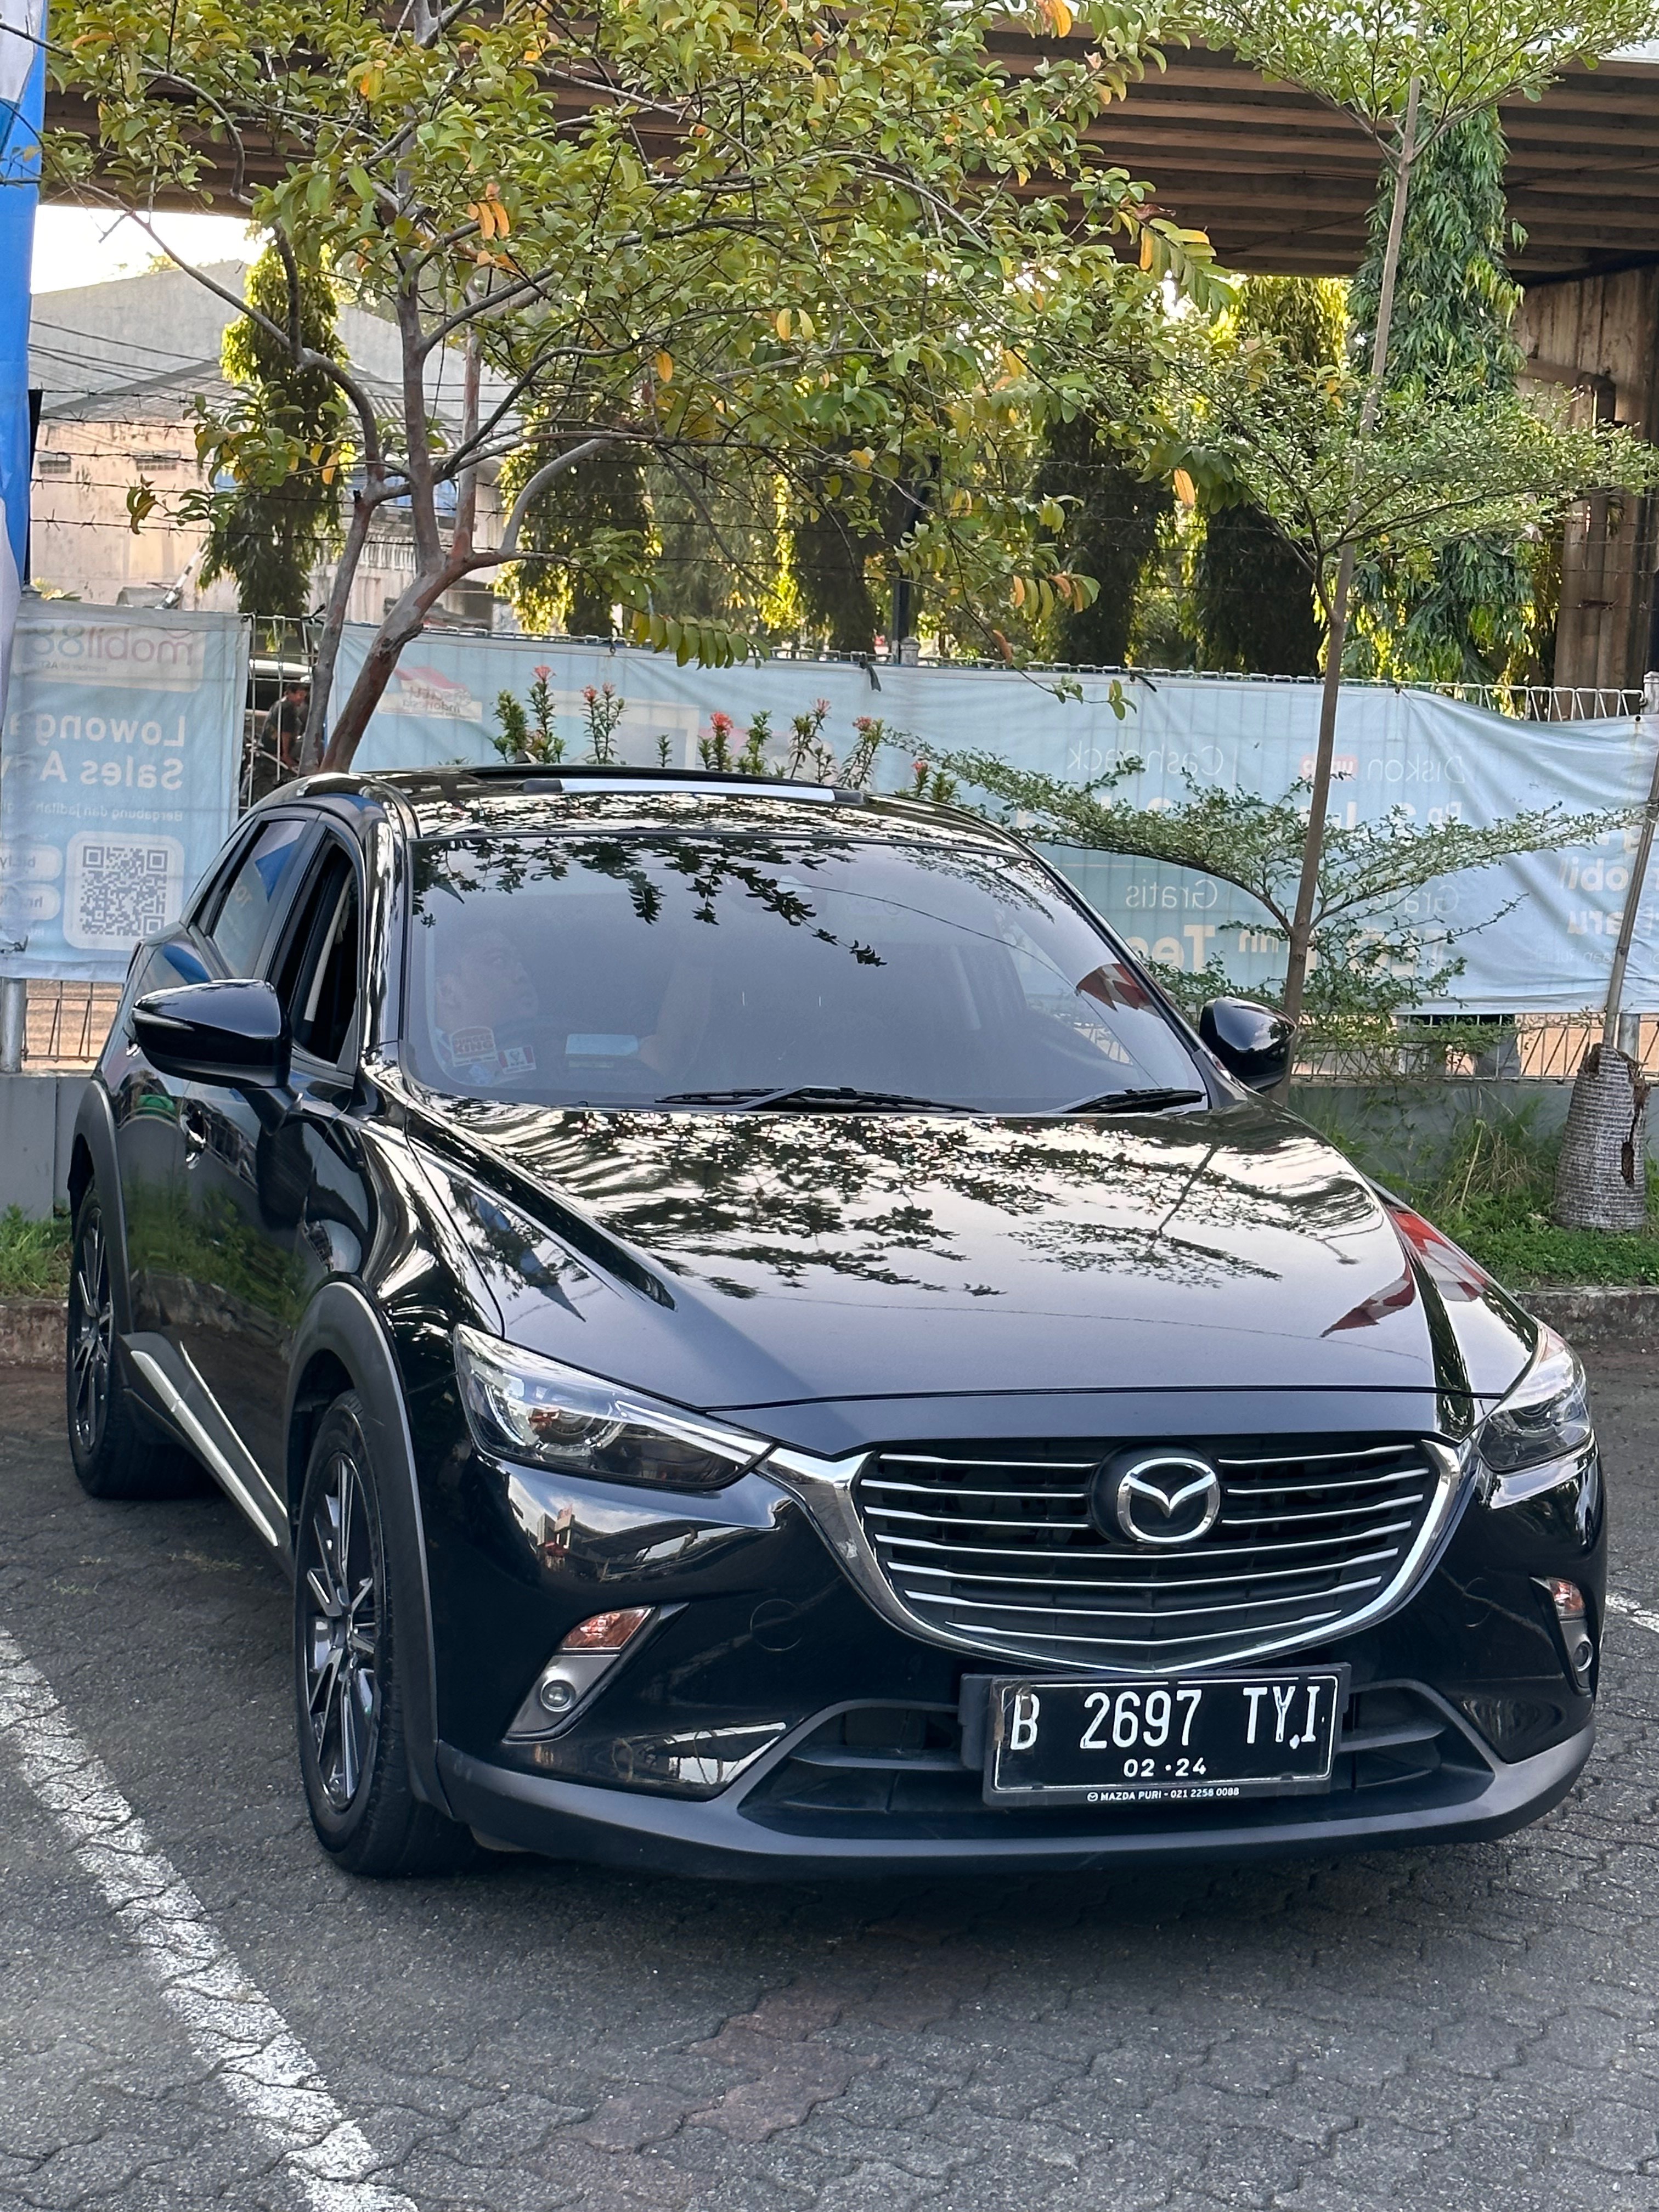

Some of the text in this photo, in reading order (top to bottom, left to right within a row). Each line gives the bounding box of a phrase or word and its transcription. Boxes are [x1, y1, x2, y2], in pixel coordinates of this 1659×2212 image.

[453, 1040, 494, 1054] KING
[1009, 1693, 1040, 1750] B
[1079, 1689, 1202, 1749] 2697
[1100, 1791, 1136, 1801] MAZDA
[1138, 1790, 1162, 1800] PURI
[1170, 1789, 1188, 1799] 021
[1190, 1788, 1214, 1798] 2258
